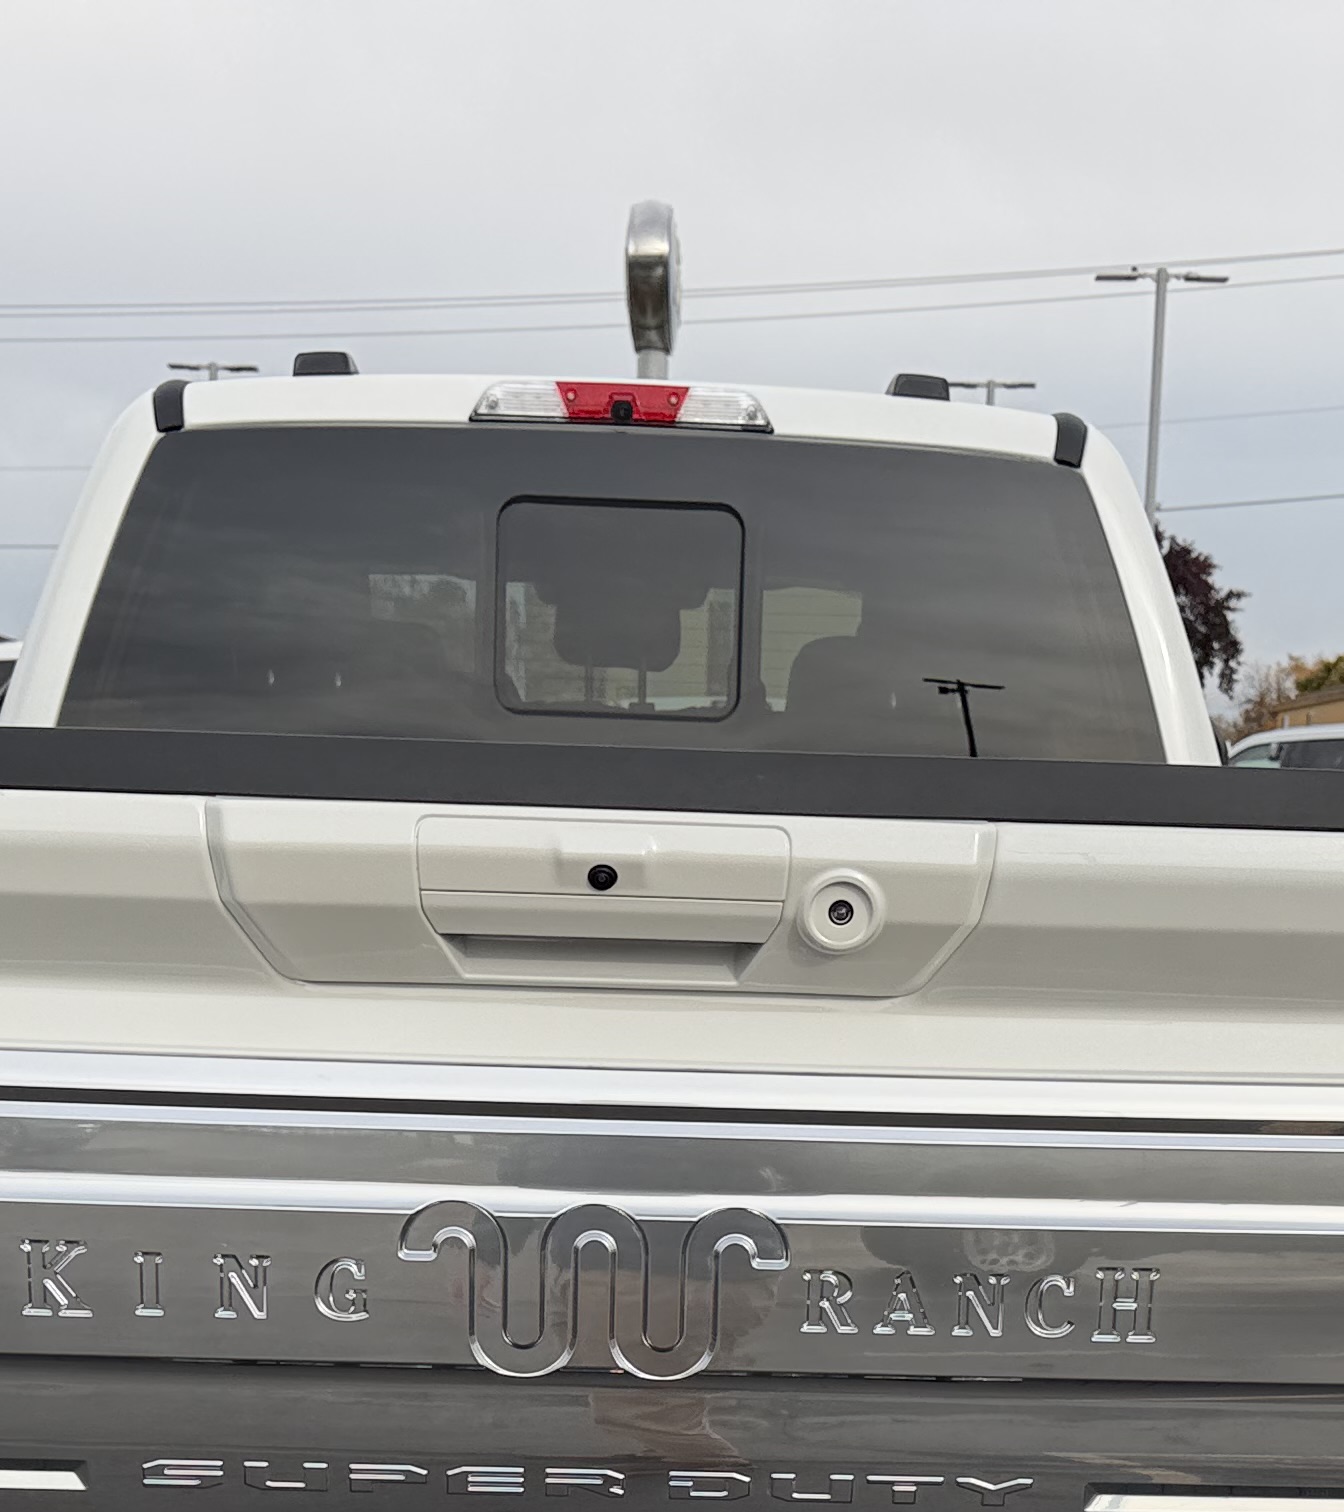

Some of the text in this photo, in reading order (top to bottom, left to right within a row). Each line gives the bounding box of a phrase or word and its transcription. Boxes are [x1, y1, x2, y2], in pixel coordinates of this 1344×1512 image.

[19, 1238, 1161, 1344] KING RANCH
[142, 1459, 1035, 1507] SUPER DUTY
